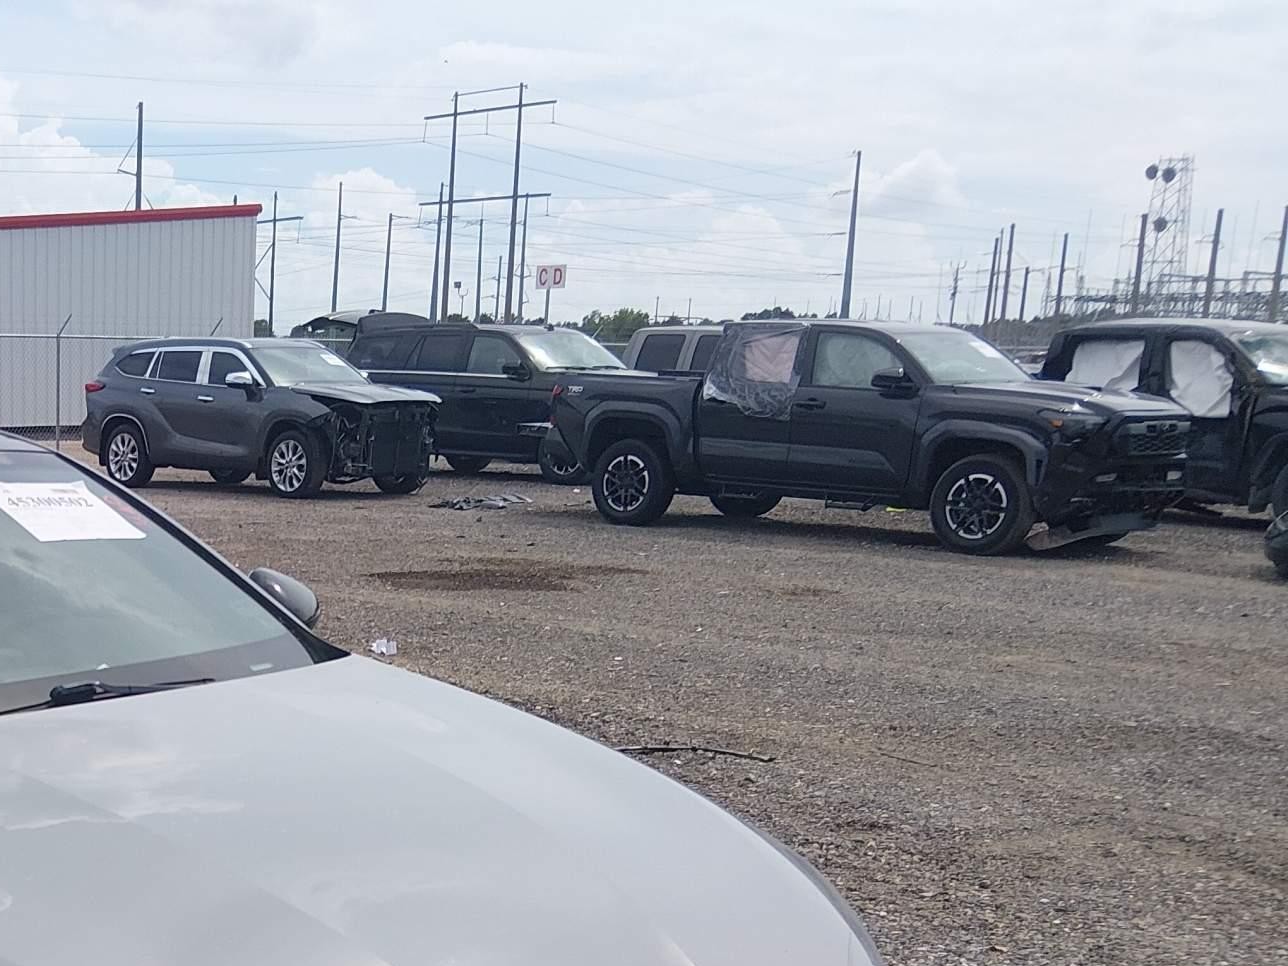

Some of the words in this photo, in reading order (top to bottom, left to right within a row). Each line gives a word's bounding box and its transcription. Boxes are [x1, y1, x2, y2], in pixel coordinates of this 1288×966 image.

[539, 268, 548, 286] C
[553, 268, 562, 285] D
[568, 385, 584, 393] TRD
